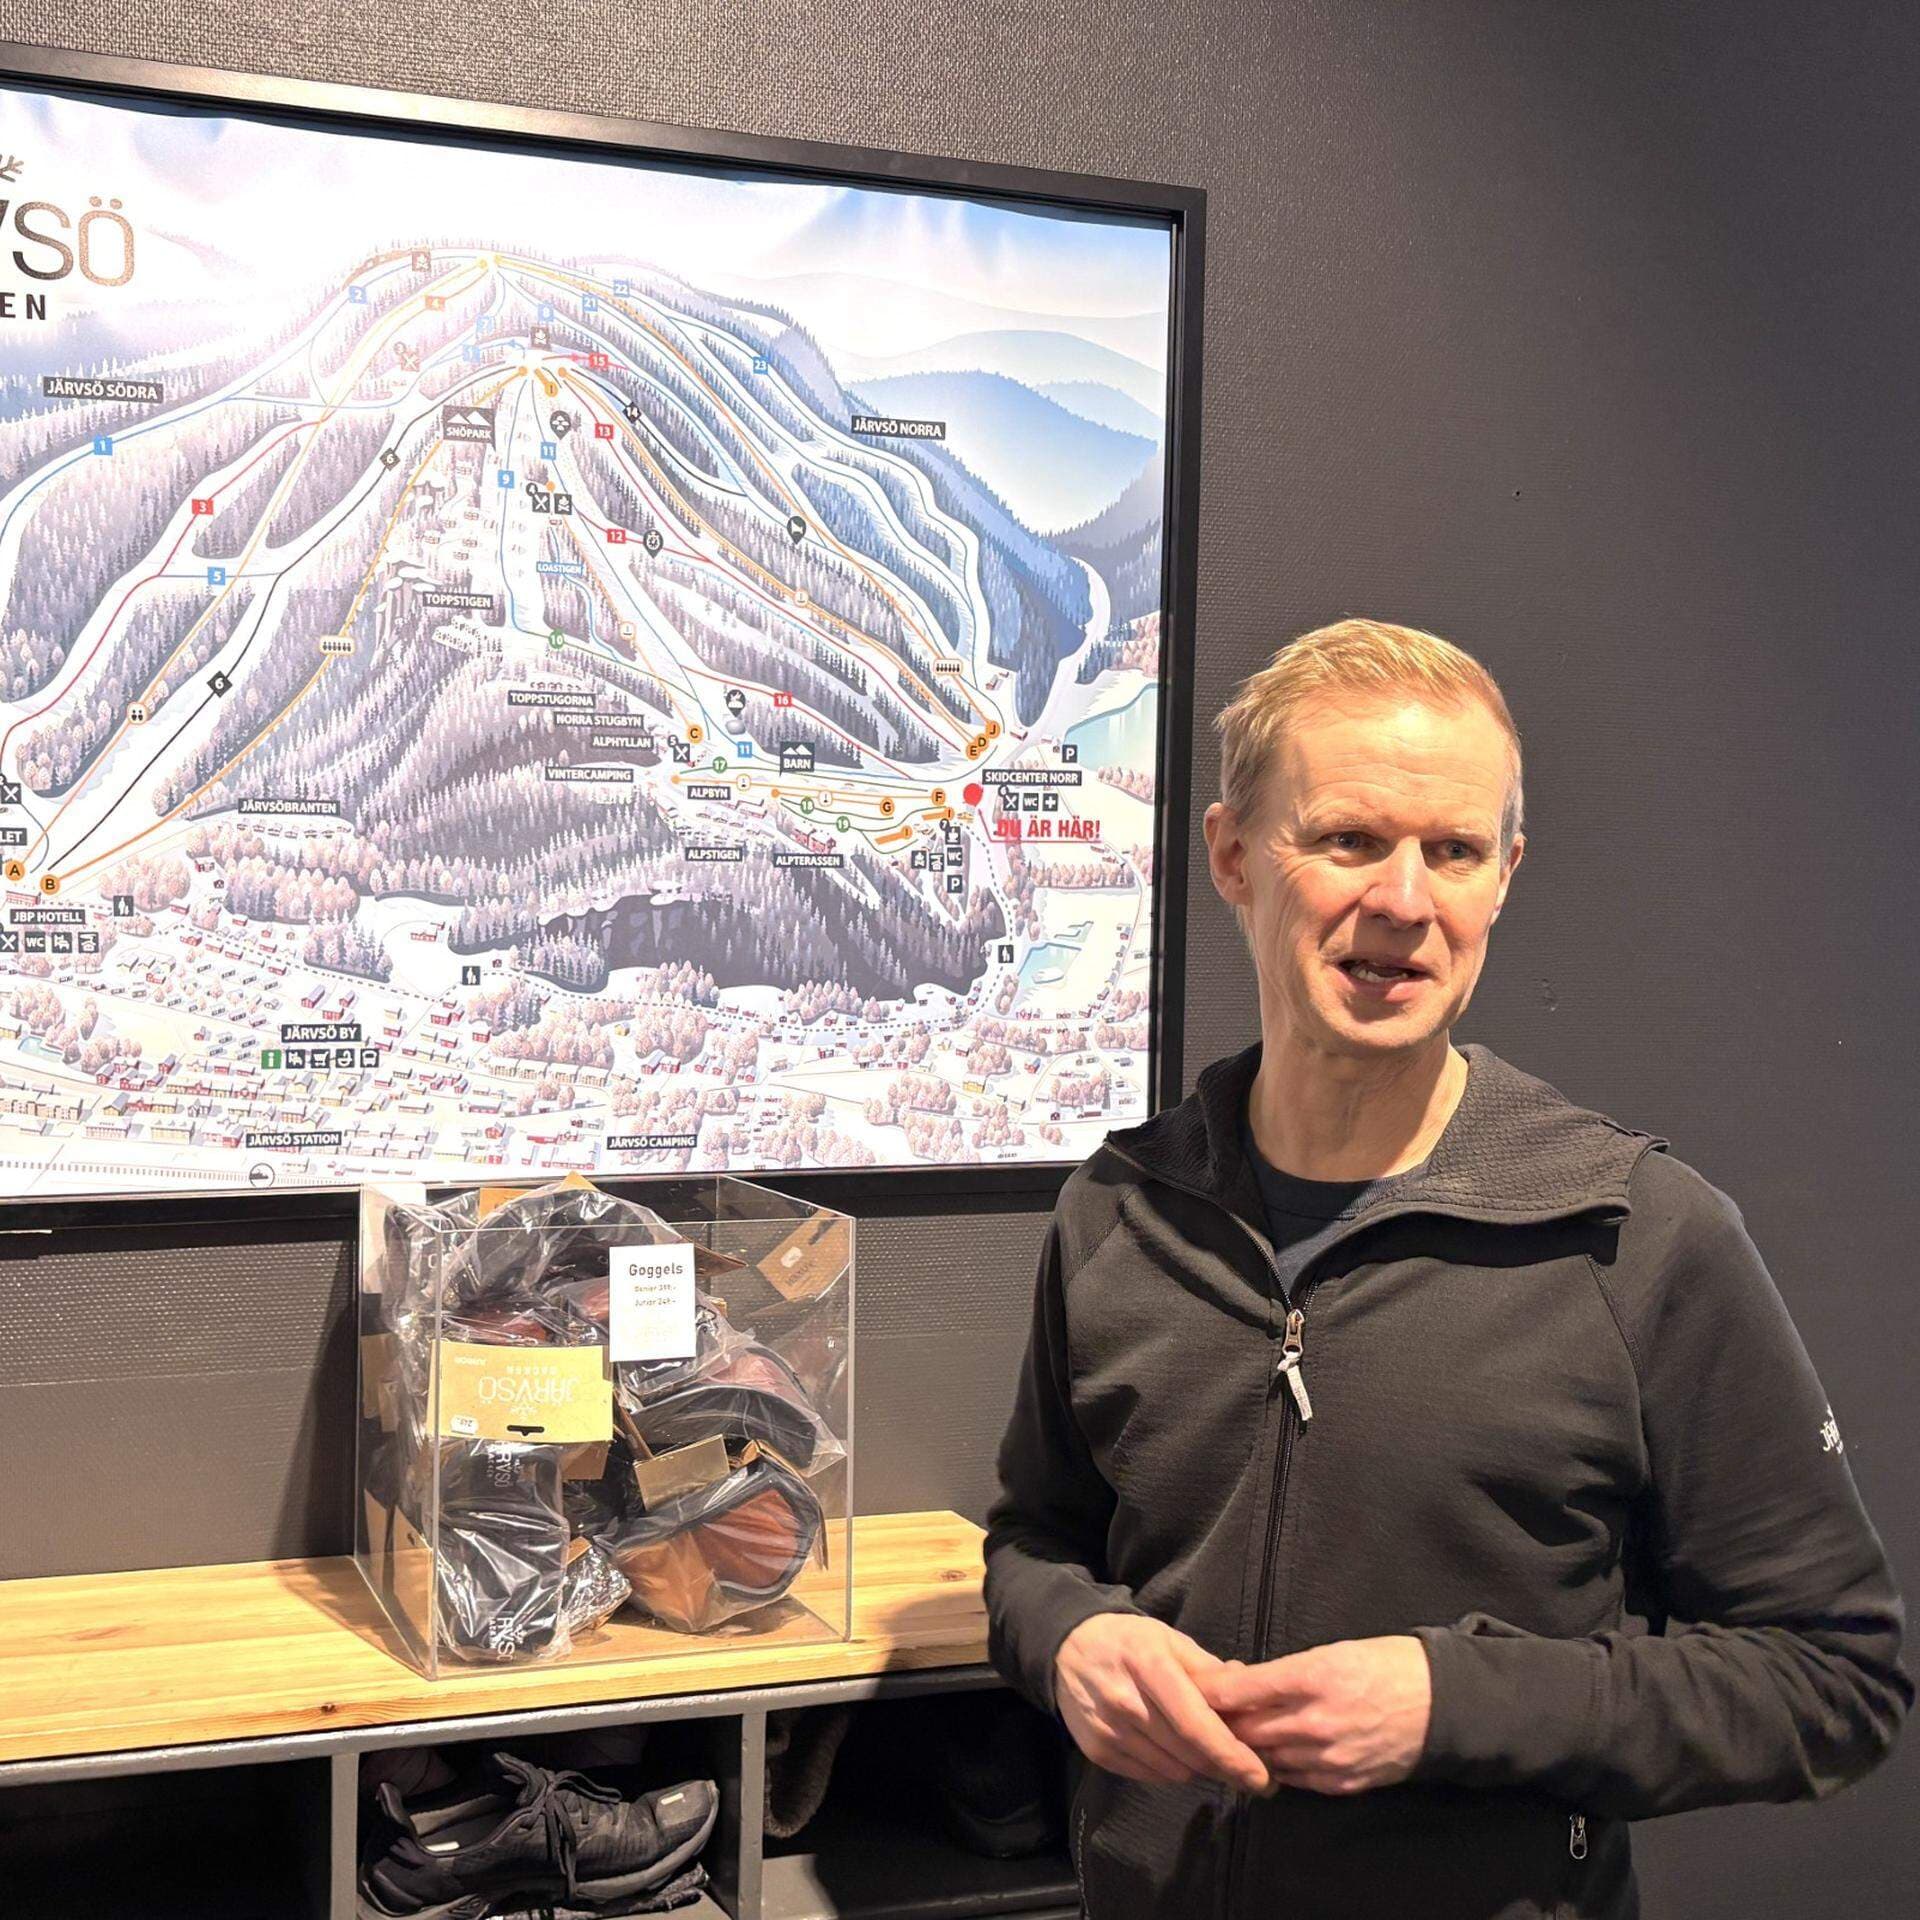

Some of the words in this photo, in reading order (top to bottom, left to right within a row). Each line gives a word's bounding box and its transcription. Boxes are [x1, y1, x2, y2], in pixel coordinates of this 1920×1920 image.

[0, 196, 135, 287] SÖ
[47, 378, 104, 397] JÄRVSÖ
[106, 382, 158, 399] SÖDRA
[446, 425, 492, 439] SNÖPARK
[854, 417, 898, 432] JÄRVSÖ
[900, 423, 942, 436] NORRA
[425, 593, 491, 608] TOPPSTIGEN
[511, 693, 594, 706] TOPPSTUGORNA
[556, 714, 592, 725] NORRA
[595, 716, 642, 727] STUGBYN
[593, 736, 651, 748] ALPHYLLAN
[783, 759, 811, 769] BARN
[548, 768, 632, 781] VINTERCAMPING
[985, 772, 1048, 783] SKIDCENTER
[1050, 772, 1078, 784] NORR
[690, 788, 728, 799] ALPBYN
[241, 799, 337, 814] JÄRVSÖBRANTEN
[997, 819, 1022, 837] DU
[1027, 815, 1052, 837] ÄR
[1058, 815, 1101, 839] HÄR!
[688, 850, 740, 860] ALPSTIGEN
[776, 856, 841, 866] ALPTERASSEN
[13, 912, 35, 922] JBP
[37, 912, 82, 923] HOTELL
[26, 937, 44, 947] WC
[284, 1024, 337, 1040] JÄRVSÖ
[340, 1026, 358, 1039] BY
[249, 1134, 292, 1146] JÄRVSÖ
[294, 1133, 339, 1145] STATION
[609, 1135, 648, 1148] JÄRVSÖ
[650, 1136, 695, 1147] CAMPING
[629, 1262, 684, 1279] Goggels
[478, 1375, 579, 1407] JÄRVSÖ
